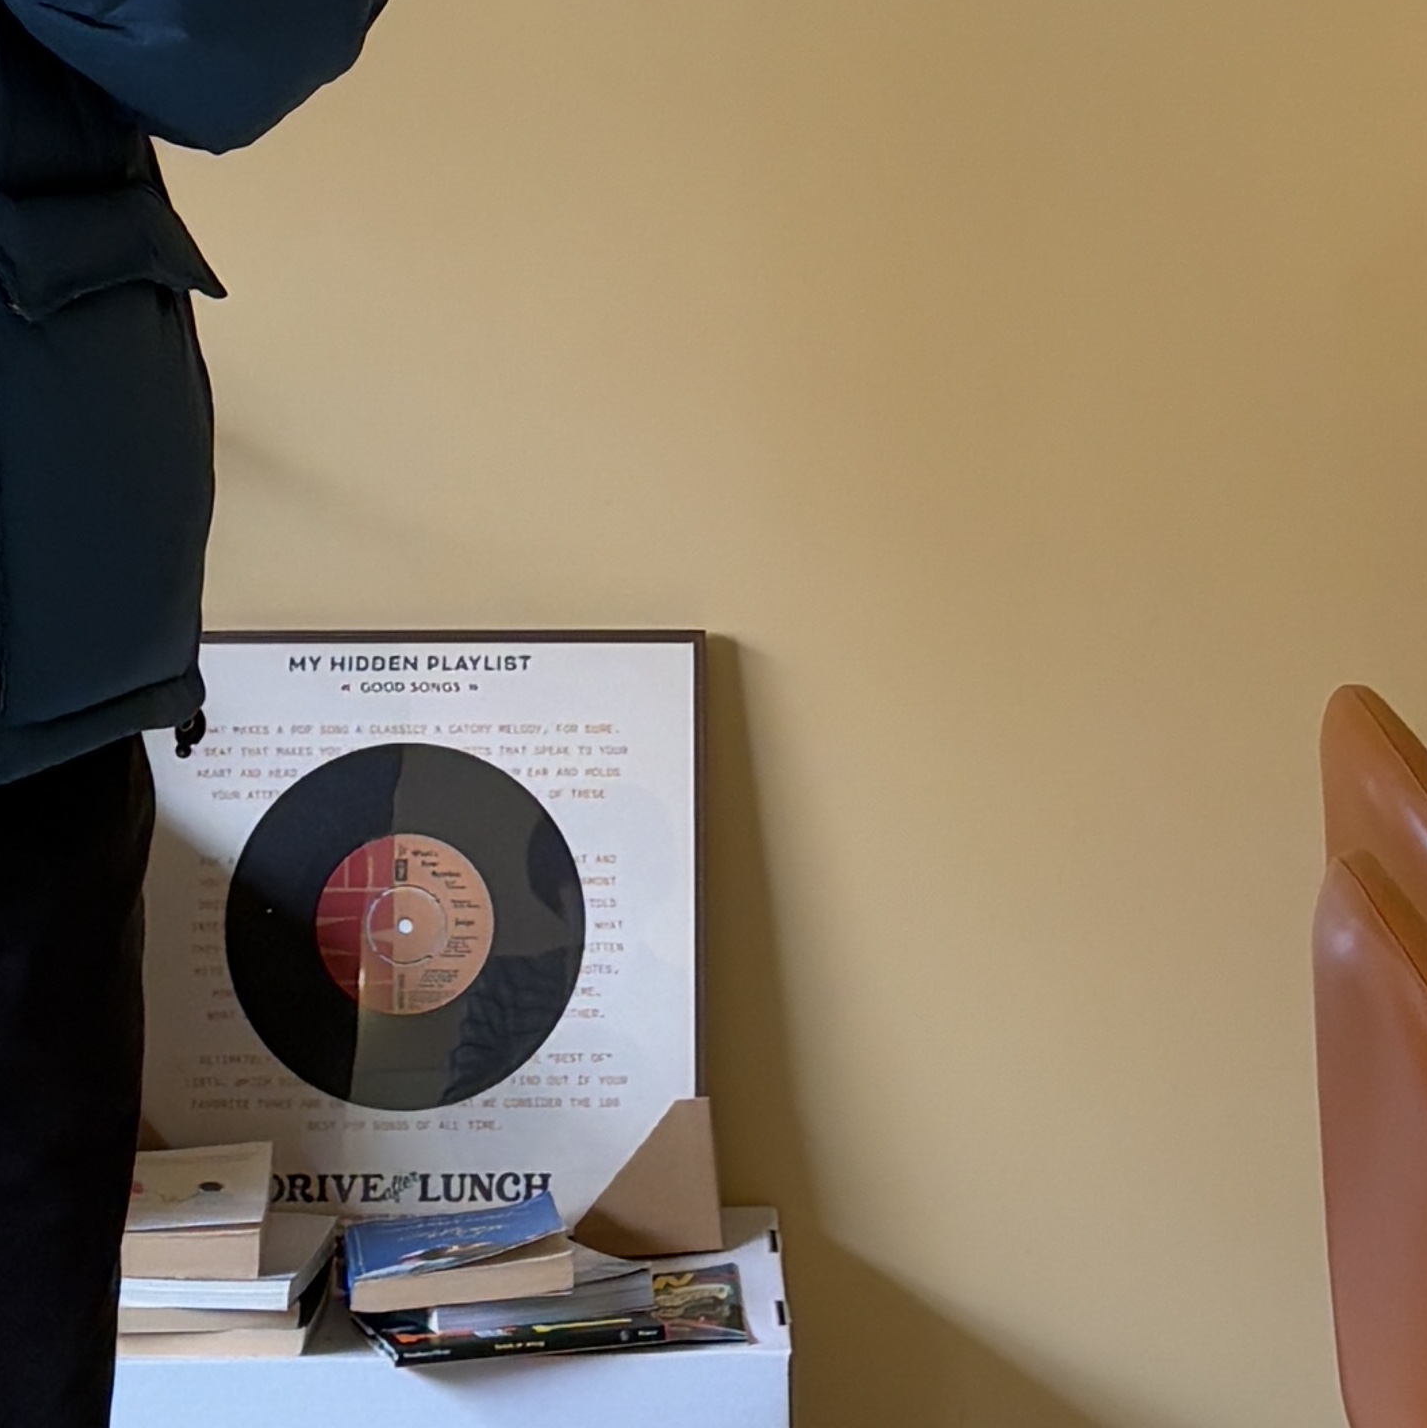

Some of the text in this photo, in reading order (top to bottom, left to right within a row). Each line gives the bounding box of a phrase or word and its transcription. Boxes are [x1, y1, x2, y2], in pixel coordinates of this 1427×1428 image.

[289, 655, 532, 672] MY HIDDEN PLAYLIST
[360, 682, 461, 693] GOOD SONGS
[418, 1173, 552, 1203] LUNCH
